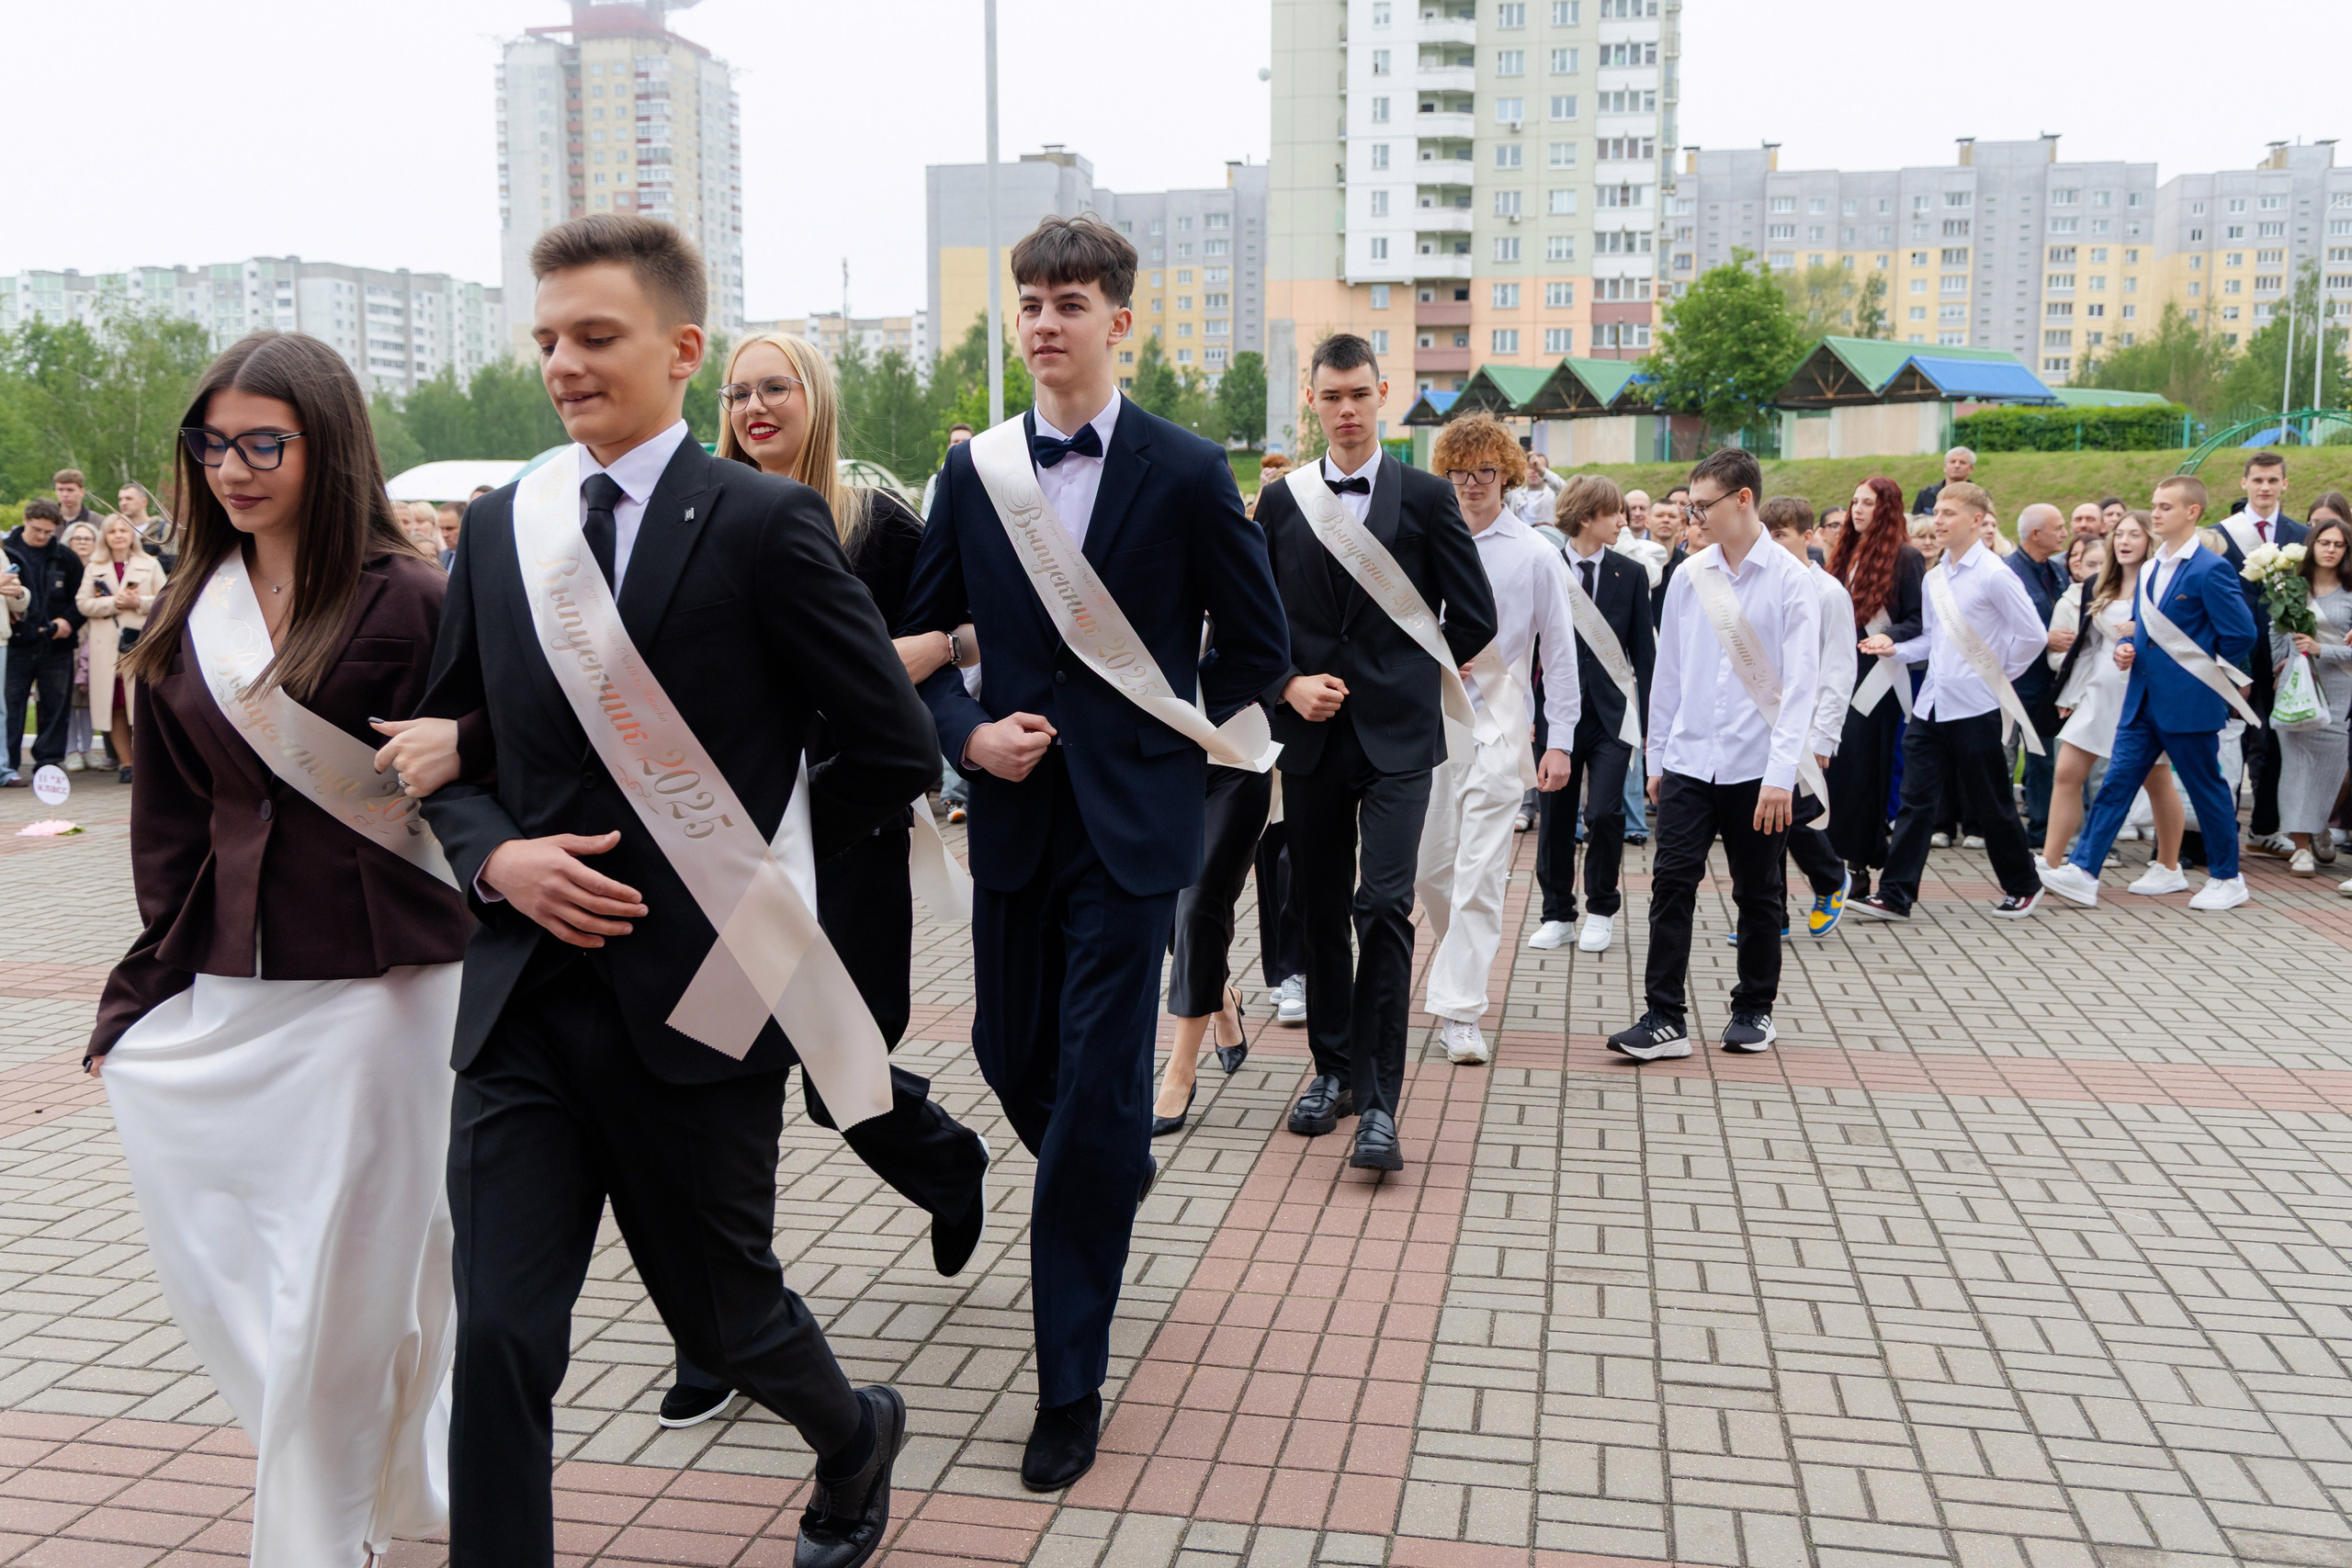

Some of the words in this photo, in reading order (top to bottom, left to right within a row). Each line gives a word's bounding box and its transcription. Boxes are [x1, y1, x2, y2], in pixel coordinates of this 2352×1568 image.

[1001, 473, 1102, 637] Выпускник
[1092, 637, 1160, 696] 2025
[1312, 495, 1396, 592] Выпускник
[534, 516, 649, 746] Выпускник
[636, 749, 735, 840] 2025
